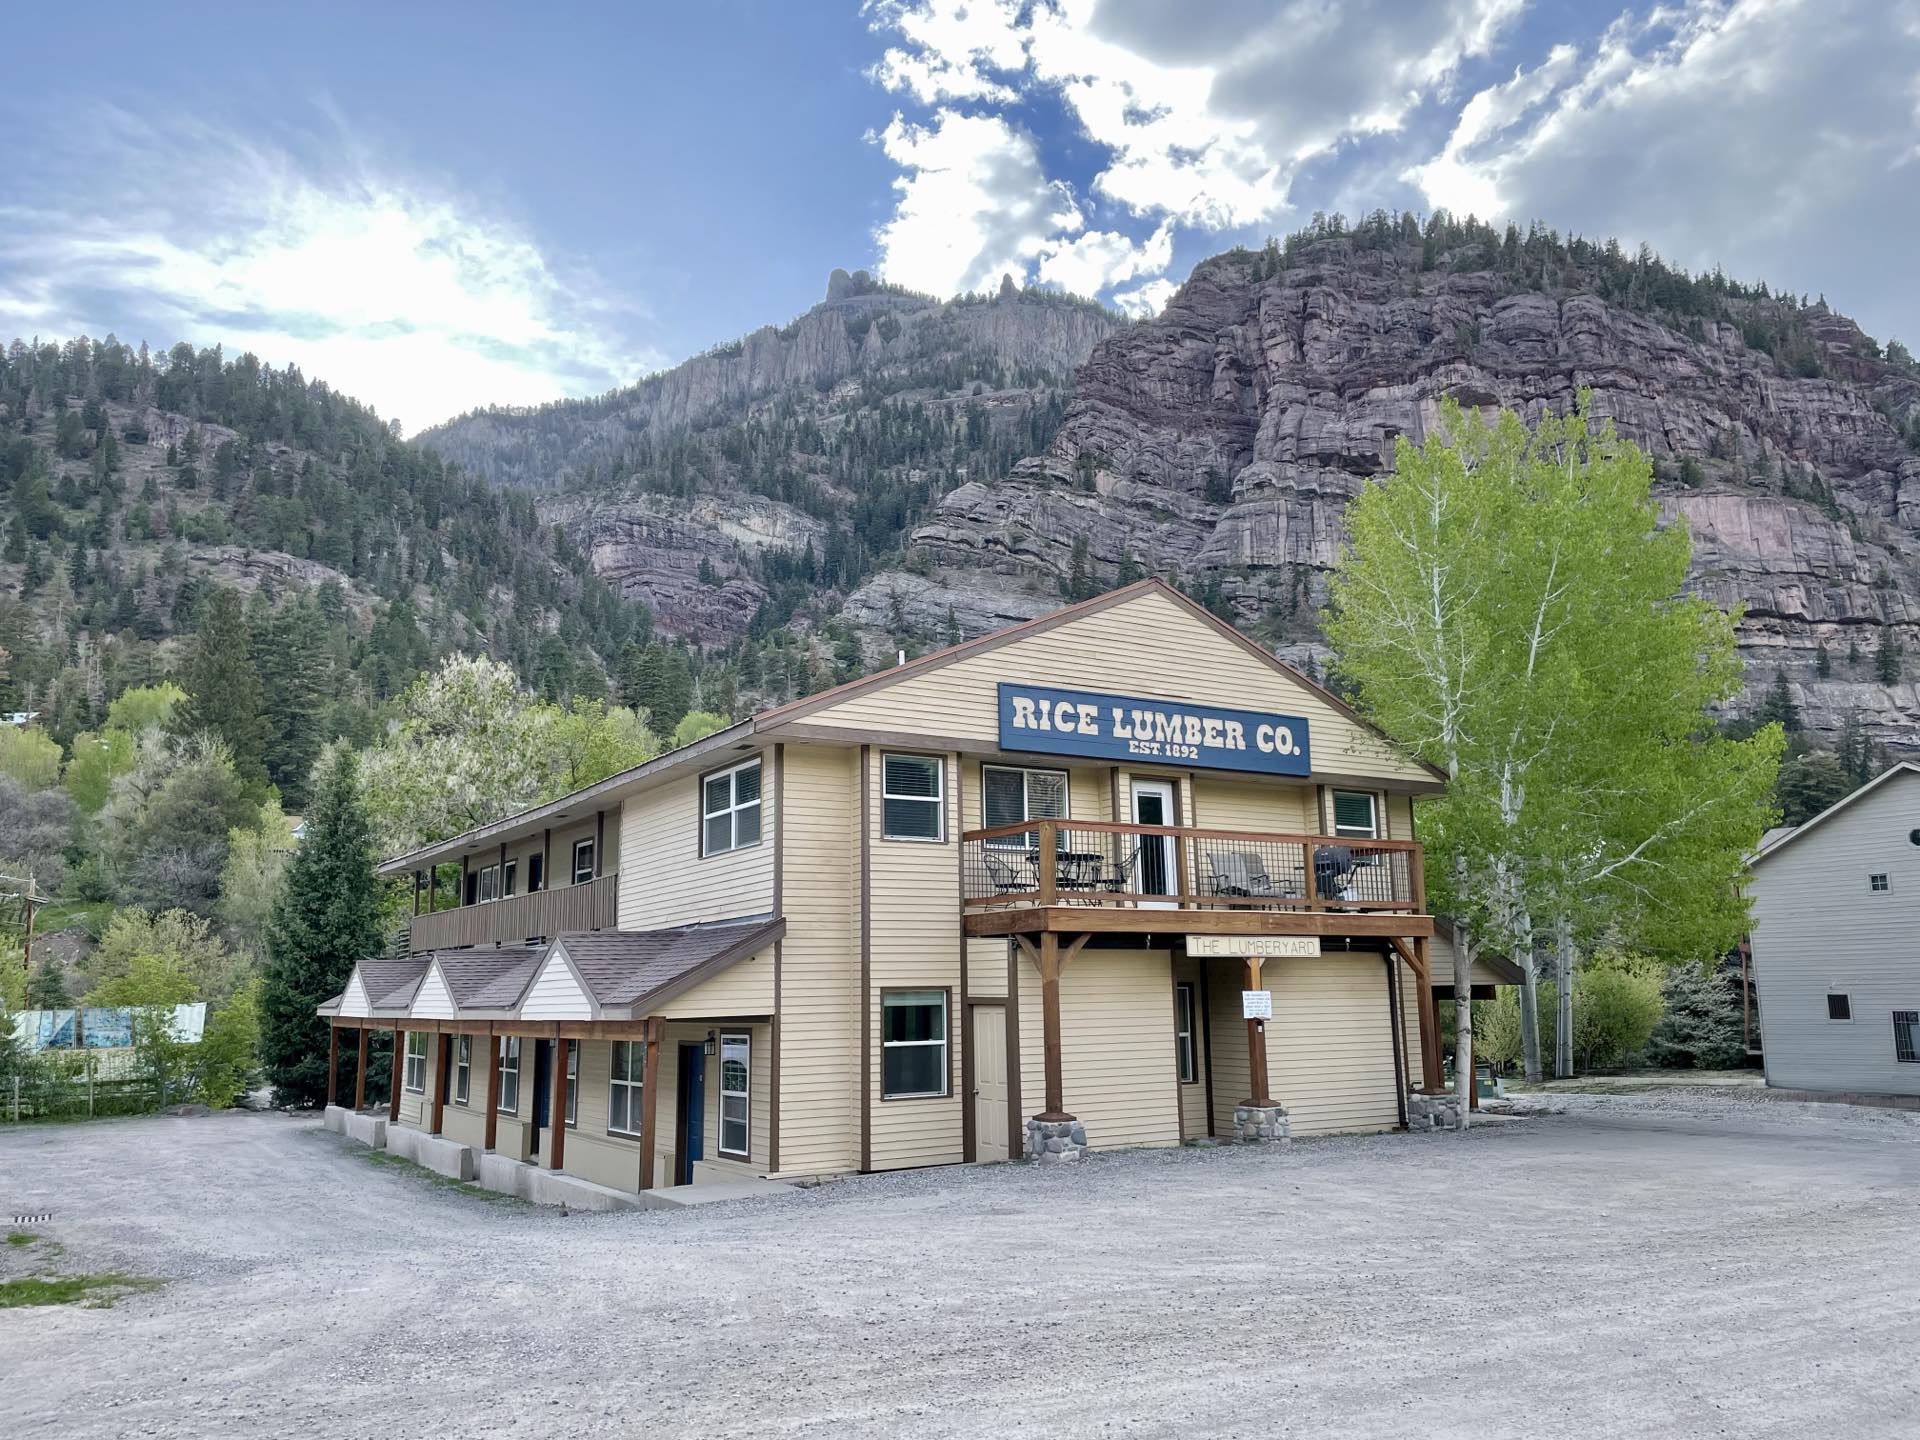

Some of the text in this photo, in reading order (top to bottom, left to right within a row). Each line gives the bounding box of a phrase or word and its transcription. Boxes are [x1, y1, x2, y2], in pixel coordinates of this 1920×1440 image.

[1012, 696, 1301, 756] RICE LUMBER CO.
[1129, 740, 1199, 760] EST. 1892
[1193, 937, 1315, 955] THE LUMBERYARD
